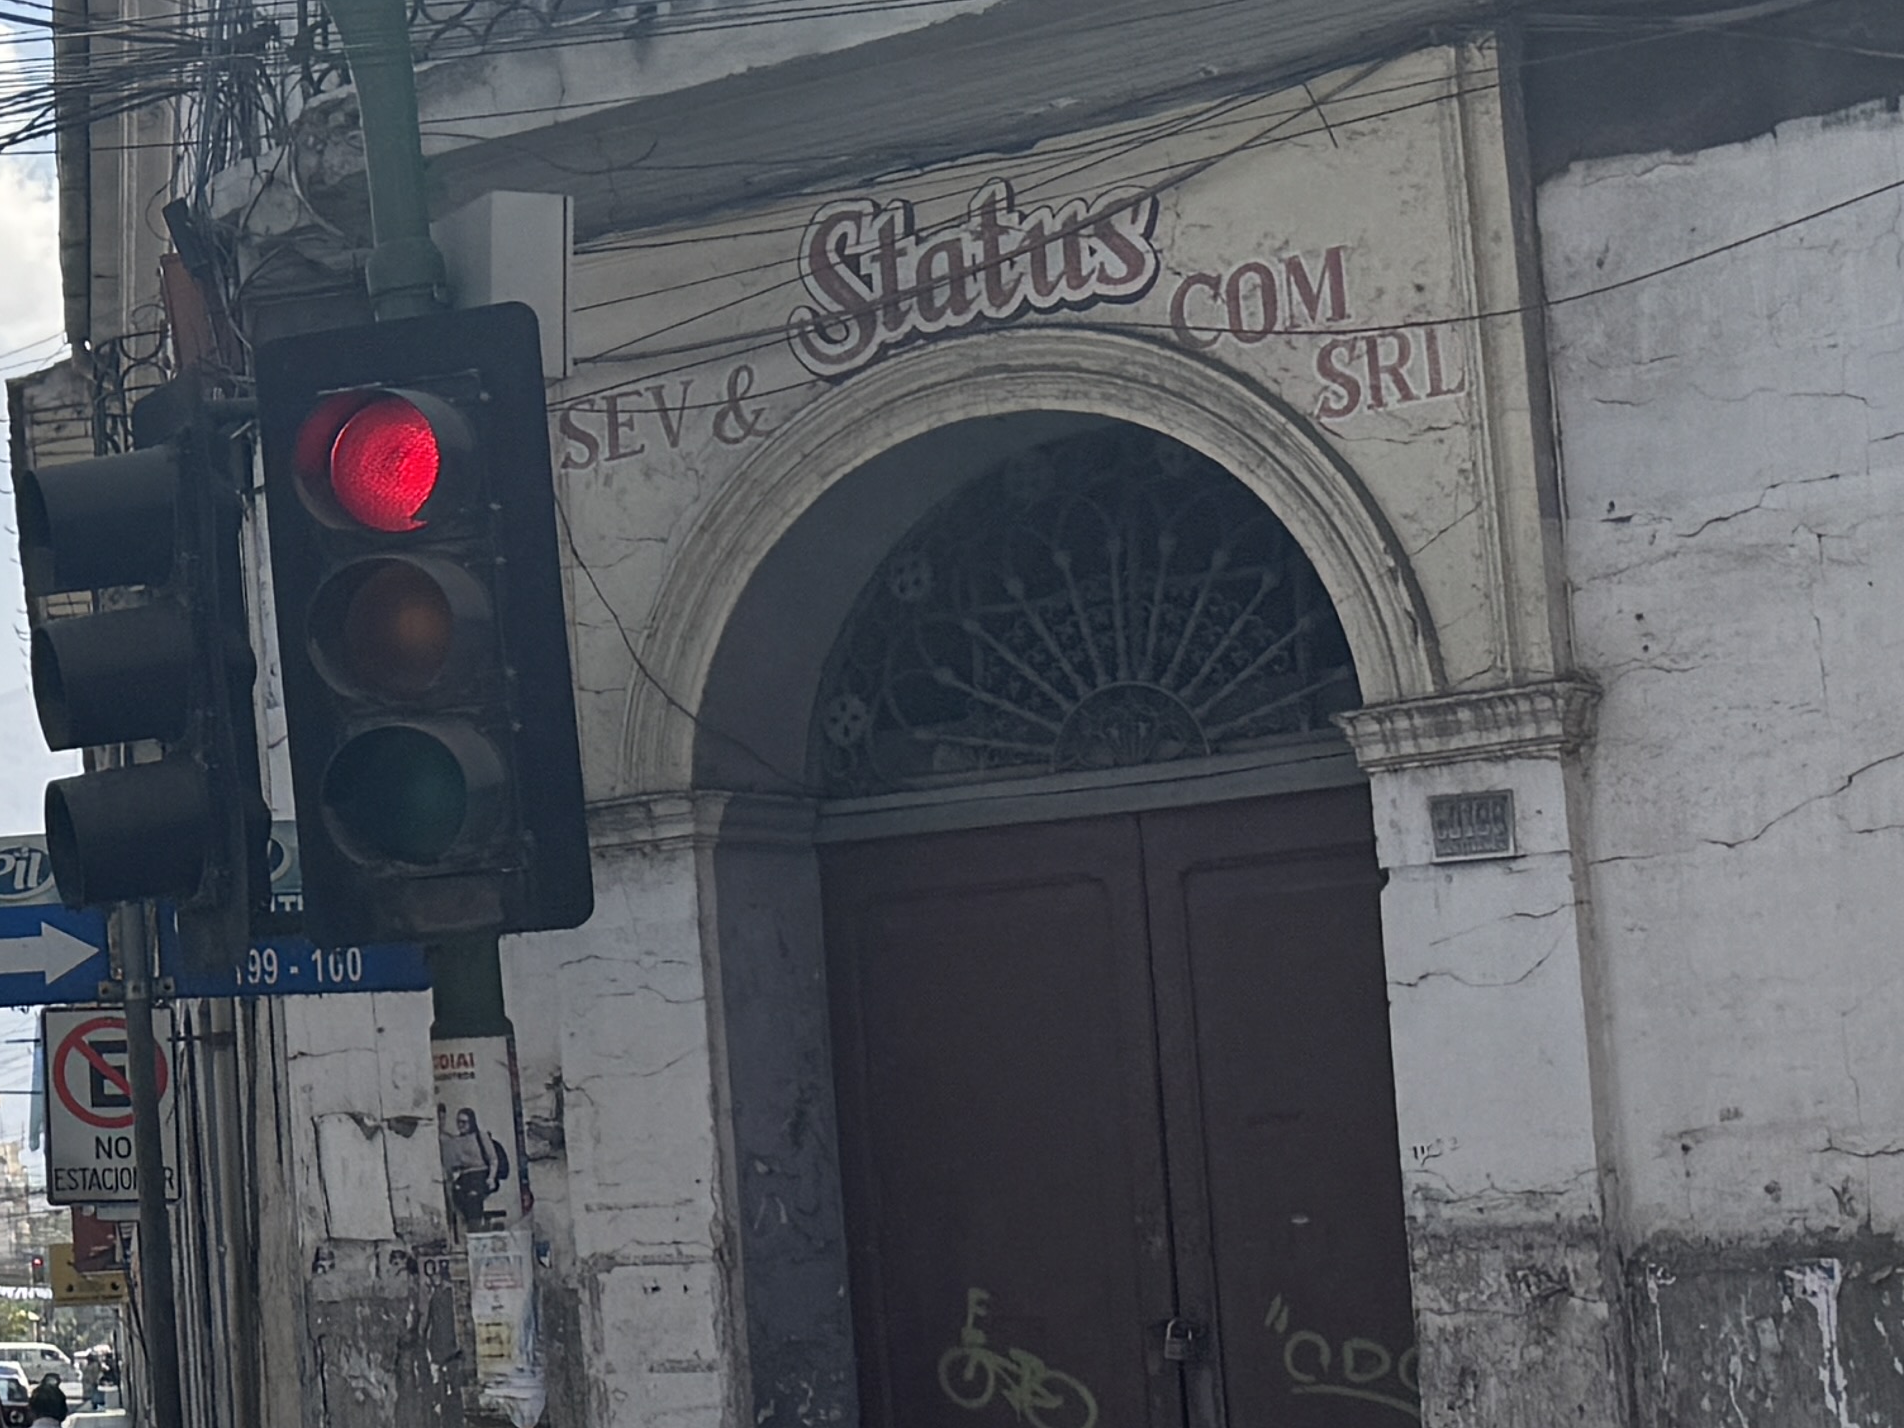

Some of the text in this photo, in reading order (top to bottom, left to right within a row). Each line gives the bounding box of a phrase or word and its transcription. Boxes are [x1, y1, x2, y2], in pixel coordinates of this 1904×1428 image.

[789, 176, 1160, 387] Status
[1170, 244, 1351, 350] COM
[712, 363, 774, 446] &
[1315, 327, 1466, 420] SRL
[94, 1135, 132, 1160] NO
